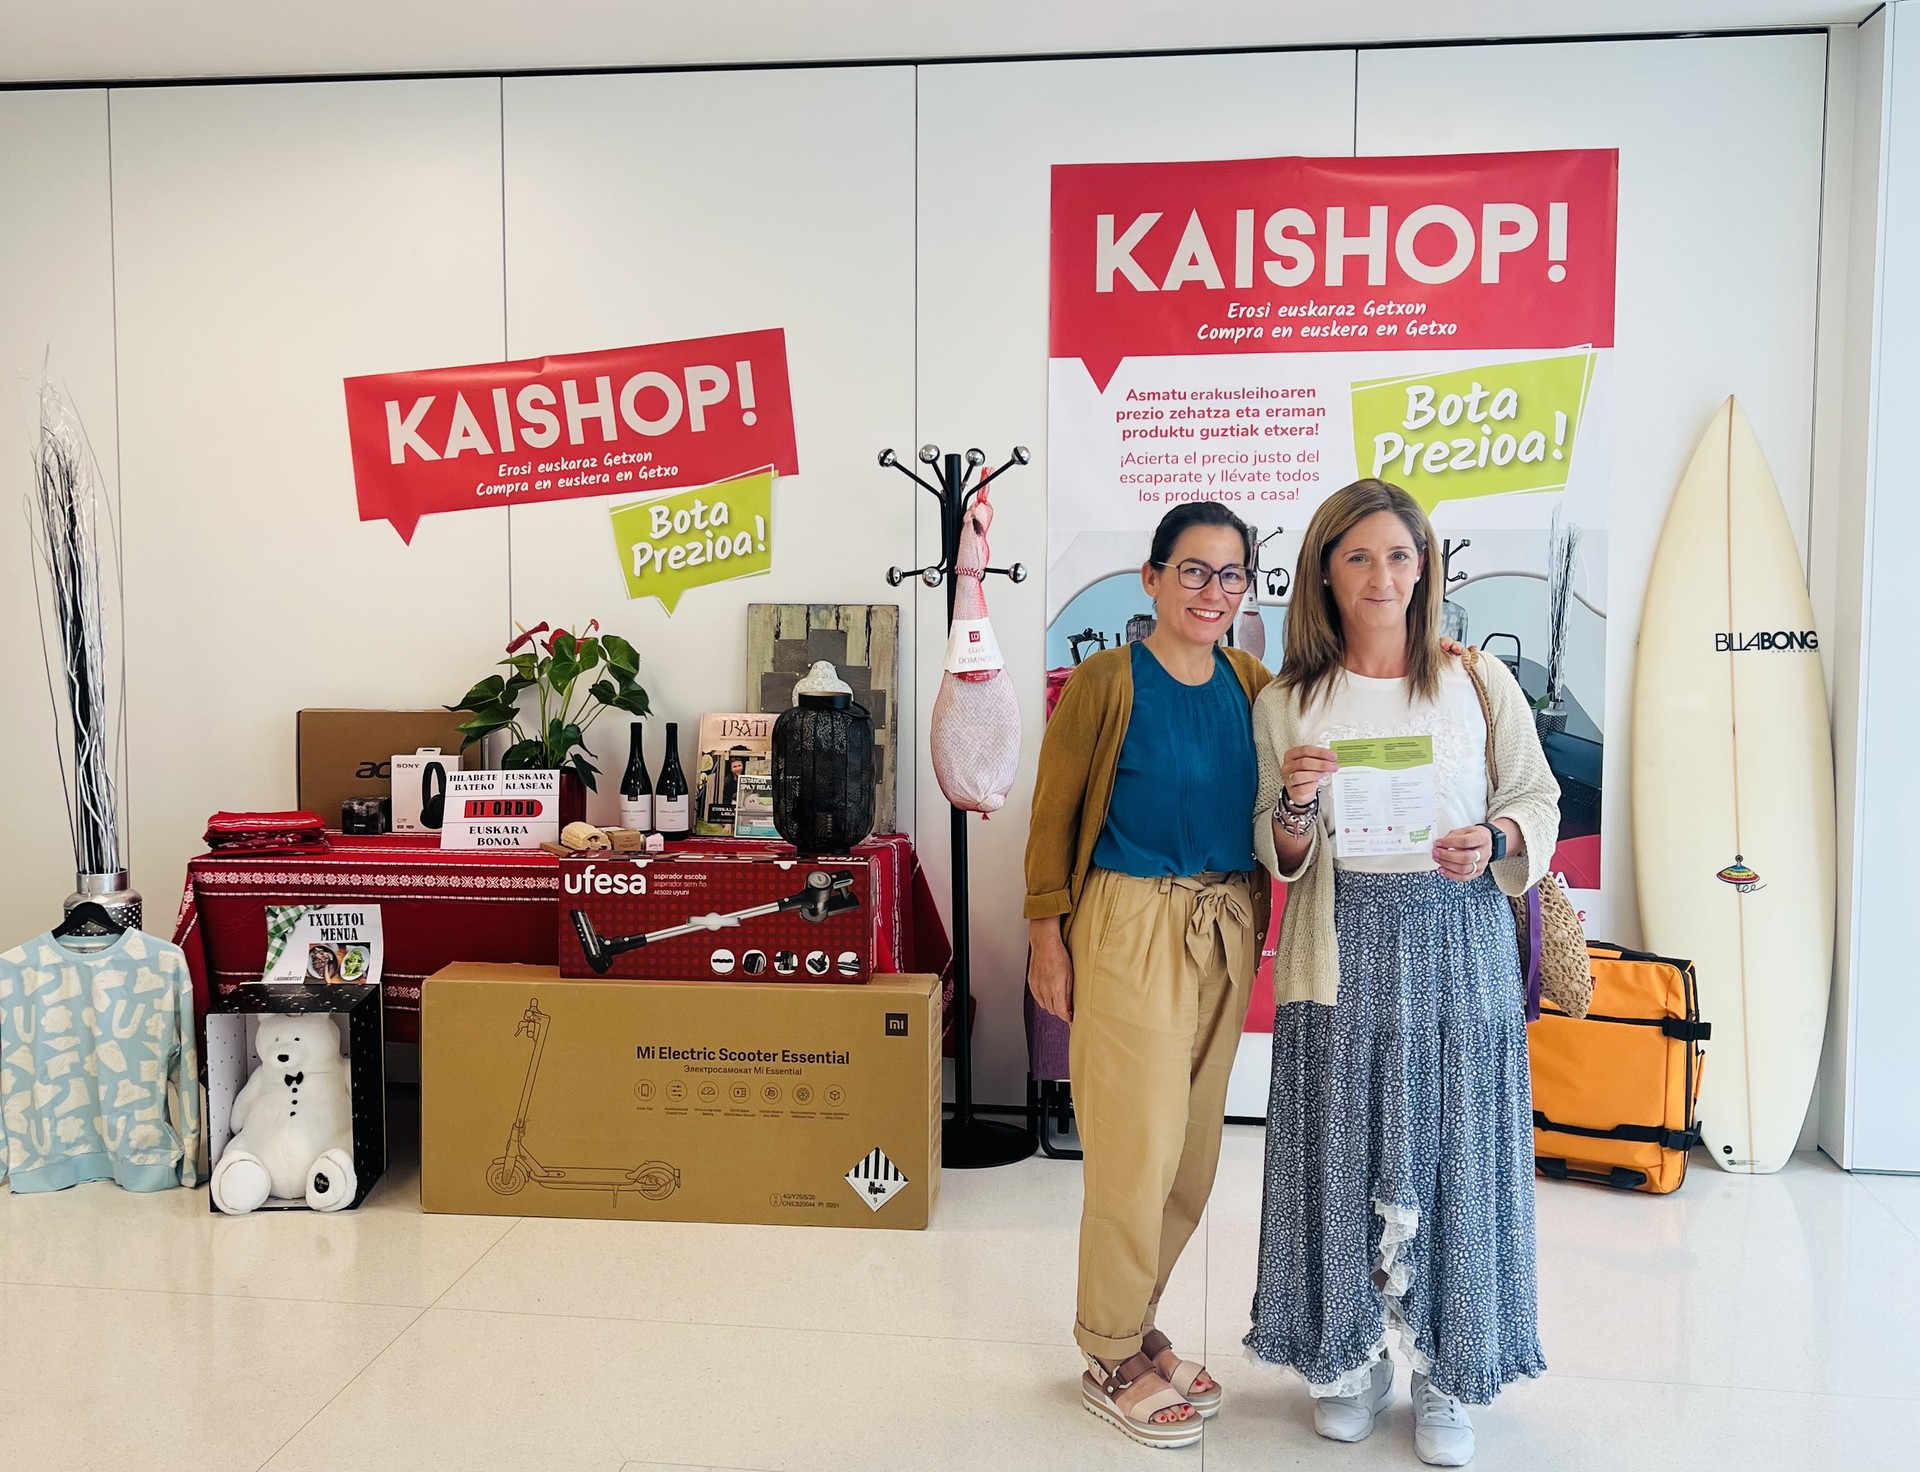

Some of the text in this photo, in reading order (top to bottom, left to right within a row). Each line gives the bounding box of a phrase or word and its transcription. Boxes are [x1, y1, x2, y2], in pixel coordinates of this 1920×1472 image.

[1095, 202, 1569, 293] KAISHOP!
[1227, 300, 1427, 319] Erosi euskaraz Getxon
[1197, 319, 1457, 344] Compra en euskera en Getxo
[1126, 386, 1316, 402] Asmatu erakusleihoaren
[384, 359, 757, 465] KAISHOP!
[1116, 406, 1326, 423] prezio zehatza eta eraman
[1402, 381, 1518, 431] Bota
[1122, 423, 1320, 442] produktu guztiak etxera!
[1371, 410, 1568, 479] Prezioa!
[498, 451, 653, 477] Erosi euskaraz Getxon
[1120, 450, 1320, 468] ¡Acierta el precio justo del
[476, 464, 679, 497] Compra en euskera en Getxo
[1119, 468, 1320, 487] escaparate y llévate todos
[1138, 487, 1300, 504] los productos a casa!
[649, 499, 729, 540] Bota
[631, 515, 766, 577] Prezioa!
[1715, 630, 1819, 652] BILLABONG
[449, 774, 498, 782] HILABETE
[505, 773, 554, 781] EUSKARA
[505, 782, 553, 790] KLASEAK
[454, 783, 495, 791] BATEKO
[472, 801, 535, 816] 11 ORDU
[469, 826, 529, 835] EUSKARA
[477, 837, 520, 846] BONOA
[564, 864, 647, 895] ufesa
[653, 872, 683, 880] aspirador
[672, 889, 690, 897] uyuni
[308, 912, 365, 926] TXULETOI
[320, 927, 358, 941] MENUA
[636, 1046, 850, 1065] Mi Electric Scooter Essential
[683, 1064, 802, 1076] Электросамокат Mi Essential
